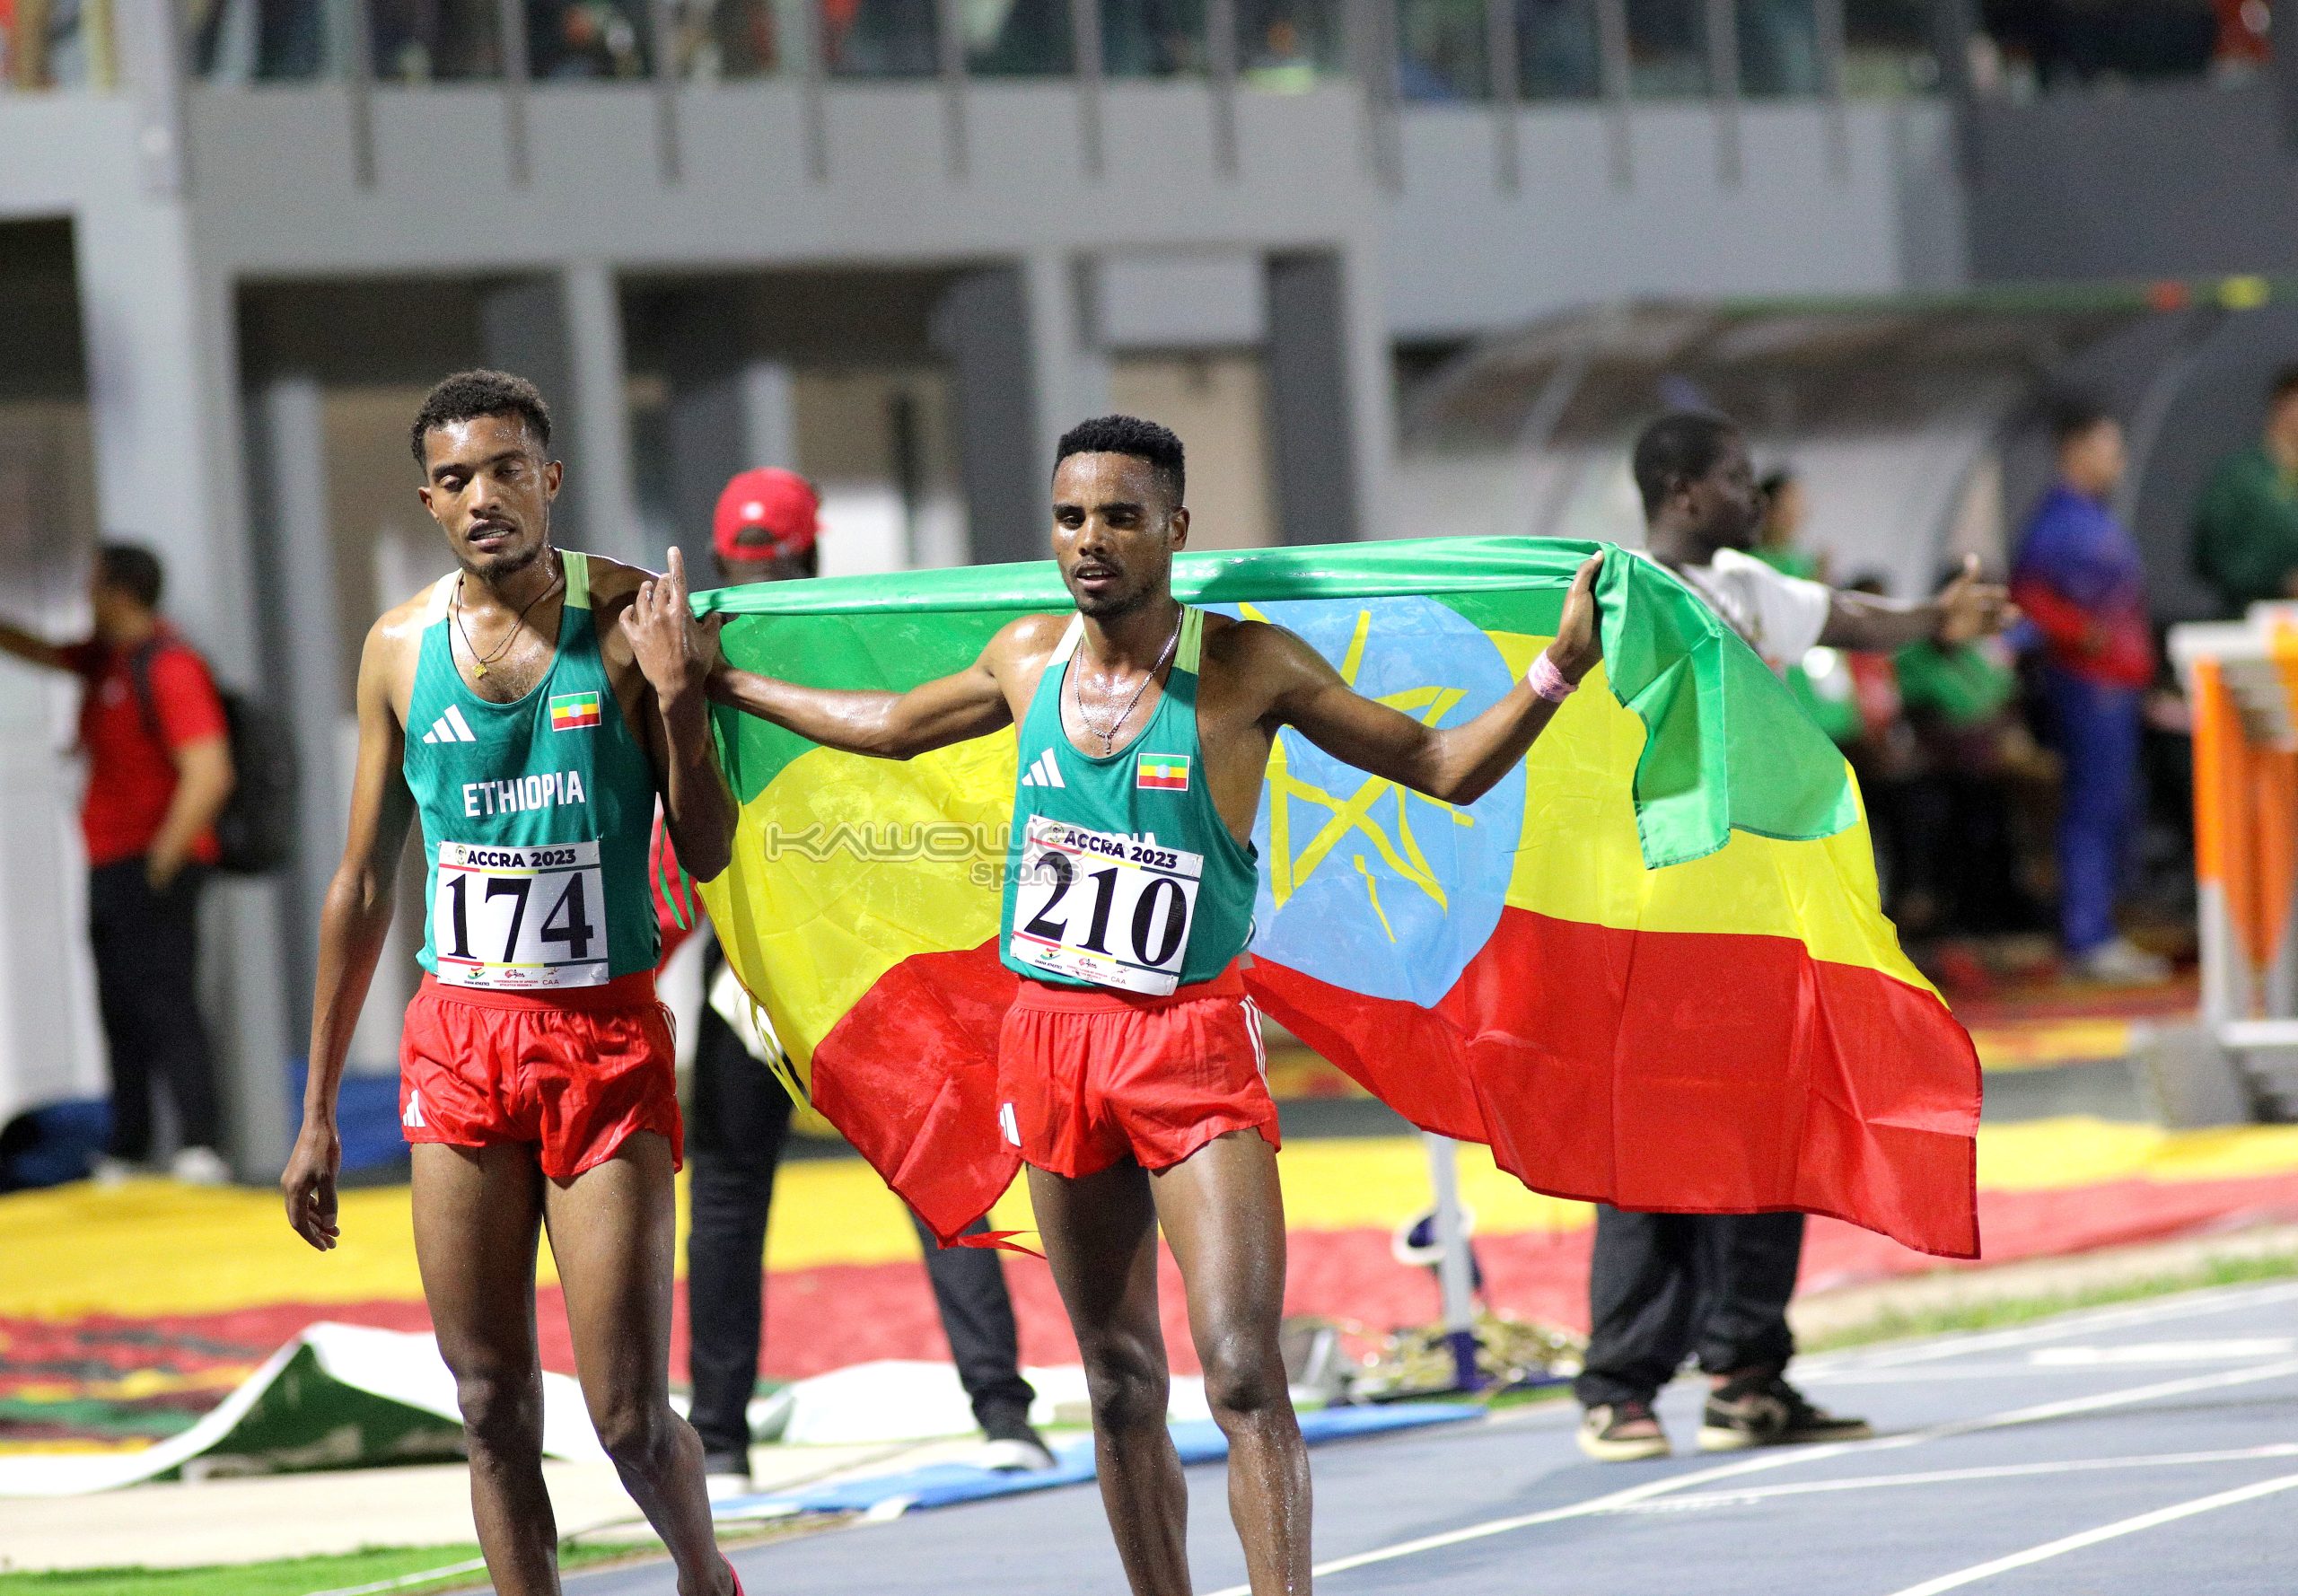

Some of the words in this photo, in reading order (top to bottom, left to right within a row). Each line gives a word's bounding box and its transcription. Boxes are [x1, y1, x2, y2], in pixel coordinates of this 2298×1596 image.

[461, 770, 586, 818] ETHIOPIA
[467, 850, 526, 867] ACCRA
[531, 848, 577, 866] 2023
[1063, 830, 1126, 859] ACCRA
[1130, 846, 1179, 870] 2023
[445, 872, 594, 963] 174
[1023, 851, 1188, 967] 210
[1110, 976, 1127, 985] CAA
